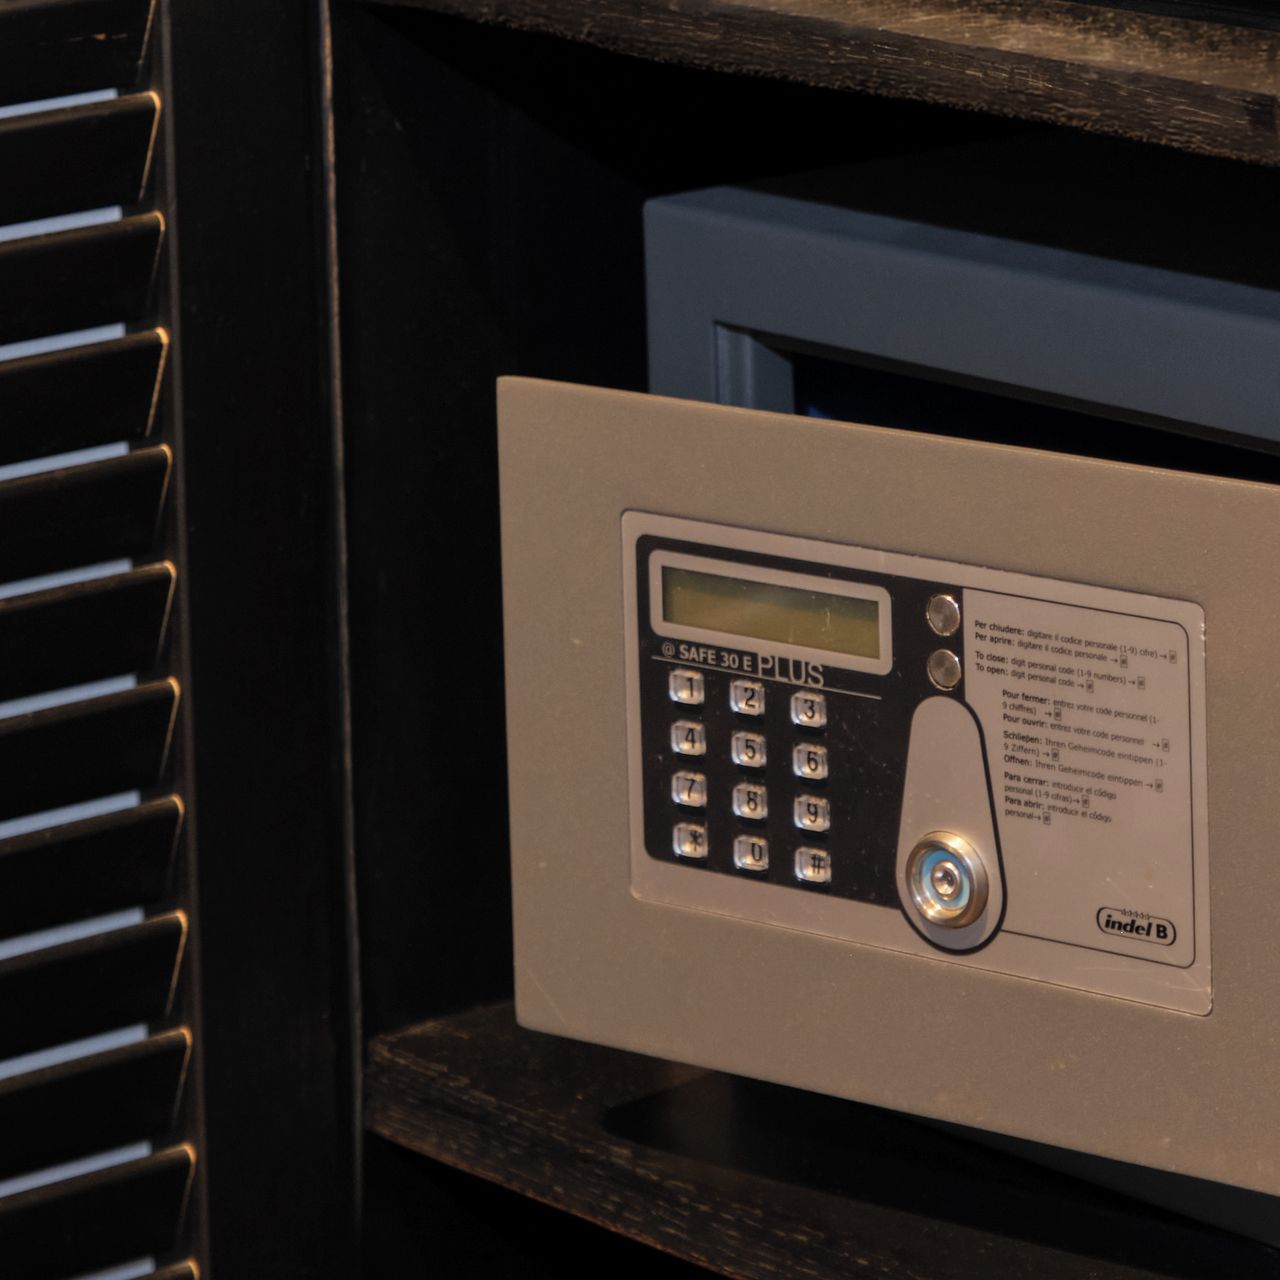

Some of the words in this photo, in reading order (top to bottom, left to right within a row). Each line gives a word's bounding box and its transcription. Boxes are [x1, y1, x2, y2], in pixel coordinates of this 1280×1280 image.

[679, 644, 716, 666] SAFE
[720, 652, 739, 670] 30
[742, 656, 753, 672] E
[758, 655, 825, 688] PLUS
[986, 652, 1009, 664] close:
[1028, 661, 1057, 672] personal
[986, 665, 1009, 677] open:
[1028, 673, 1057, 685] personal
[1002, 689, 1019, 700] Pour
[1021, 693, 1051, 705] fermer:
[1096, 706, 1113, 717] code
[1002, 713, 1020, 724] Pour
[1092, 729, 1109, 740] code
[1045, 737, 1066, 749] Ihren
[1035, 759, 1056, 772] Ihren
[1004, 771, 1021, 782] Para
[1023, 775, 1049, 787] cerrar:
[1005, 796, 1022, 807] Para
[1024, 799, 1045, 811] abrir:
[1104, 914, 1152, 937] indel
[1156, 924, 1168, 939] B
